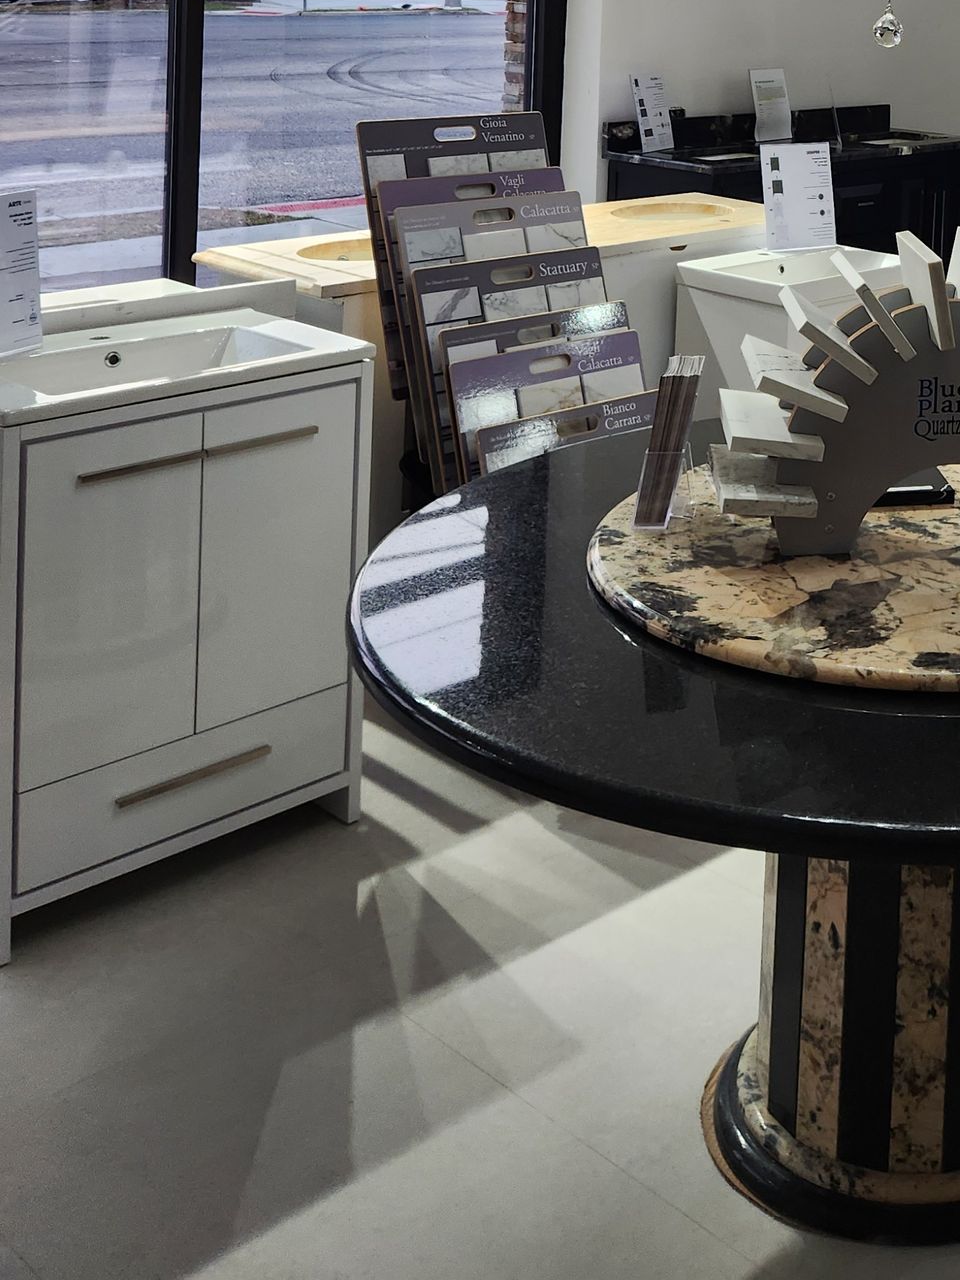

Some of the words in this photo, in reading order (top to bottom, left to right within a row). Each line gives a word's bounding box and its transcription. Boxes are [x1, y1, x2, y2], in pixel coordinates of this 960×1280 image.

[480, 116, 508, 129] Gioia
[481, 132, 525, 144] Venatino
[499, 174, 525, 187] Vagli
[520, 204, 571, 219] Calacatta
[539, 260, 588, 277] Statuary
[577, 355, 623, 373] Calacatta
[602, 401, 637, 417] Bianco
[604, 413, 642, 430] Carrara
